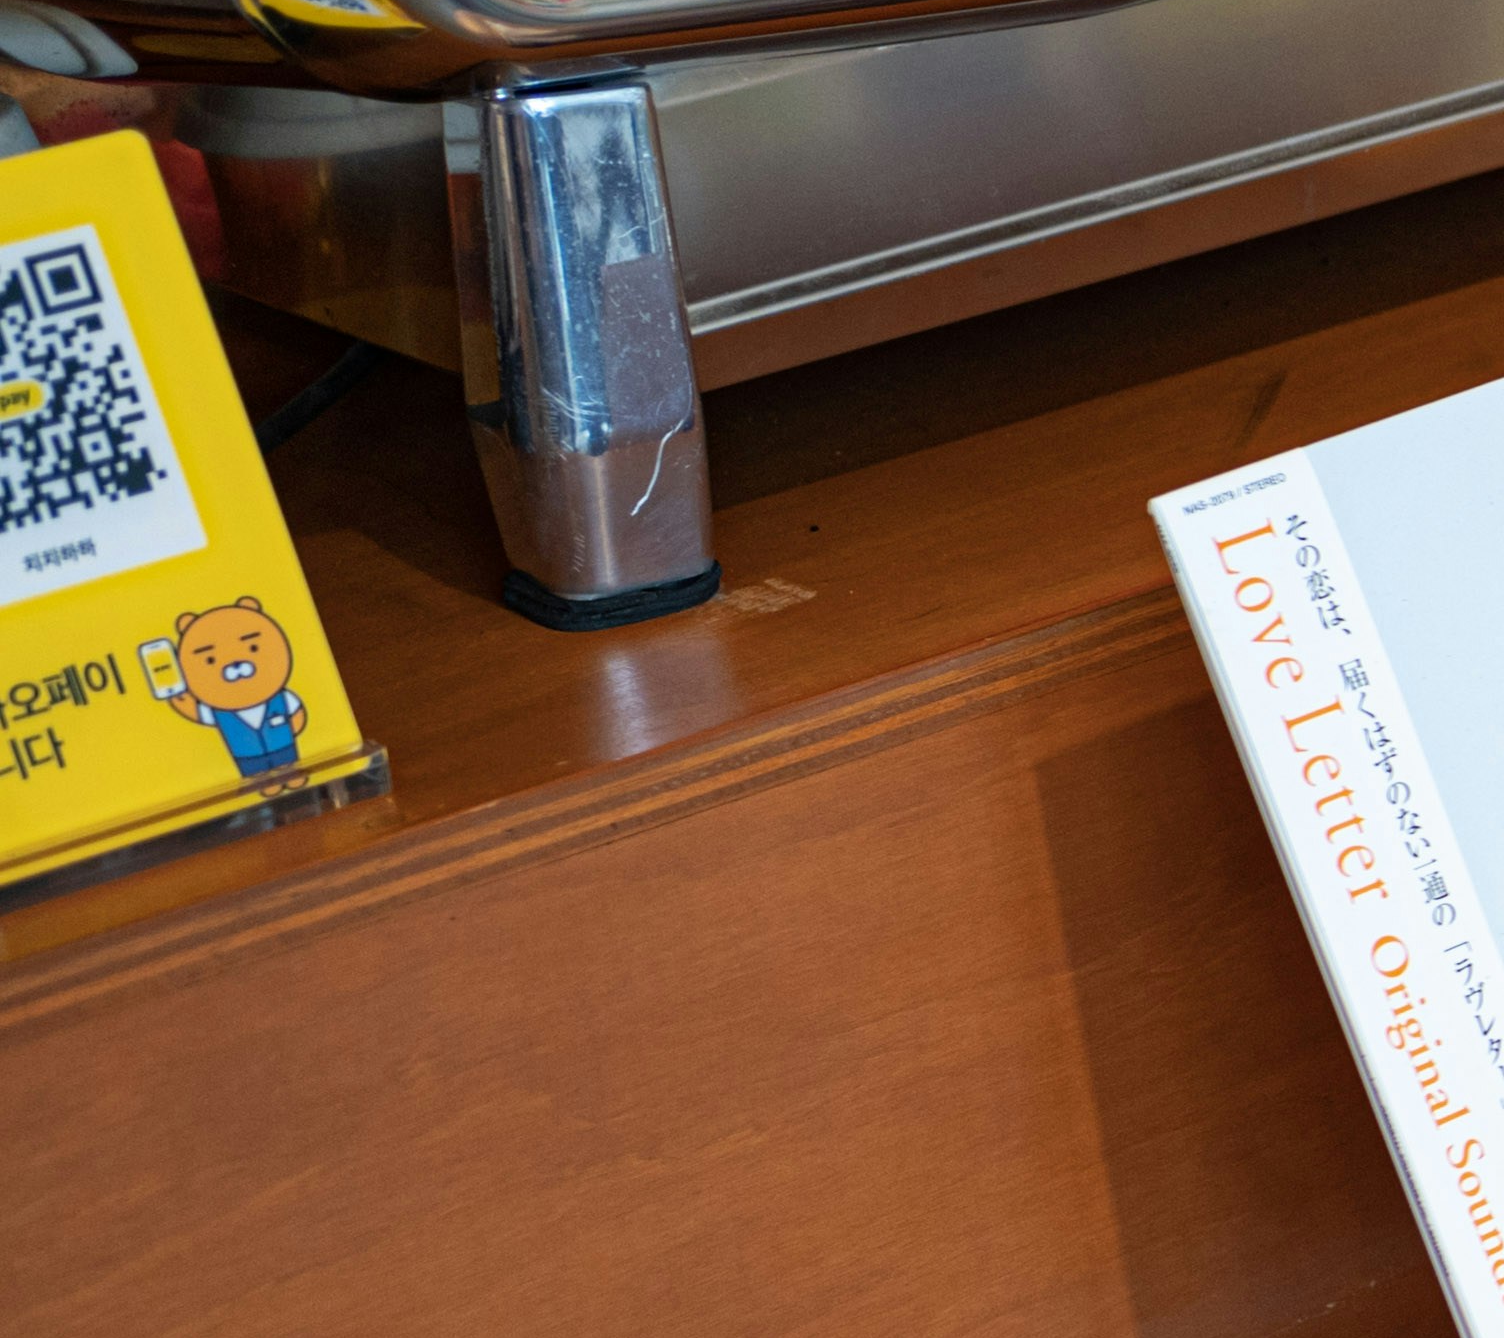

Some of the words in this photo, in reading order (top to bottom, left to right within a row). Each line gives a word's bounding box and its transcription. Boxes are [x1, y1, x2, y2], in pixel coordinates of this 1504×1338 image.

[0, 653, 127, 731] 오페이
[1212, 516, 1304, 690] Love
[1280, 695, 1390, 904] Letter
[1371, 933, 1471, 1129] Original
